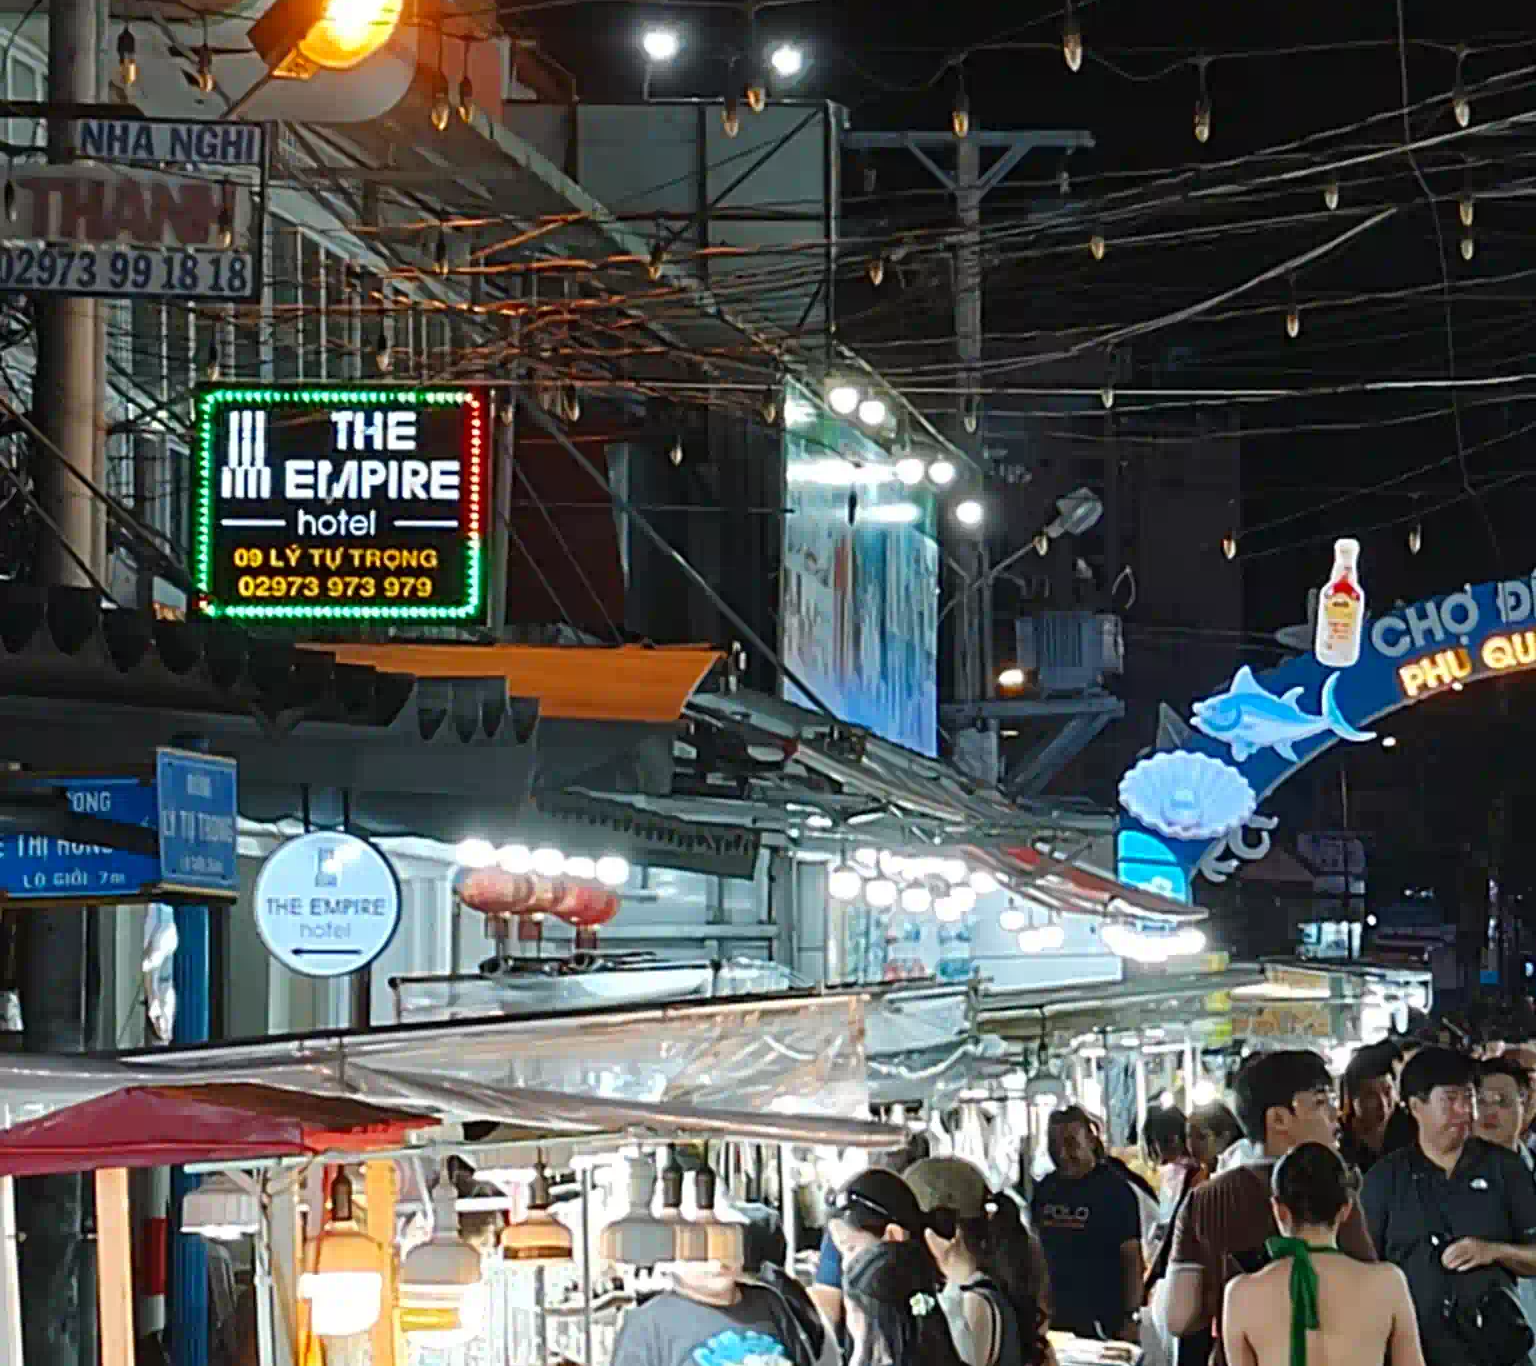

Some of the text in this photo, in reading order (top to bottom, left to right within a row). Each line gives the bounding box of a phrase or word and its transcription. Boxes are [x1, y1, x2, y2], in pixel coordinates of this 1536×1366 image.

[108, 251, 151, 288] 99
[160, 253, 200, 291] 18
[208, 255, 247, 293] 18
[331, 410, 417, 451] THE
[284, 459, 460, 501] EMPIRE
[297, 508, 376, 536] hotel
[233, 548, 263, 568] 09
[237, 576, 434, 598] 02973 973 979
[1371, 583, 1479, 657] CHỢ
[267, 898, 386, 916] THE EMPIRE
